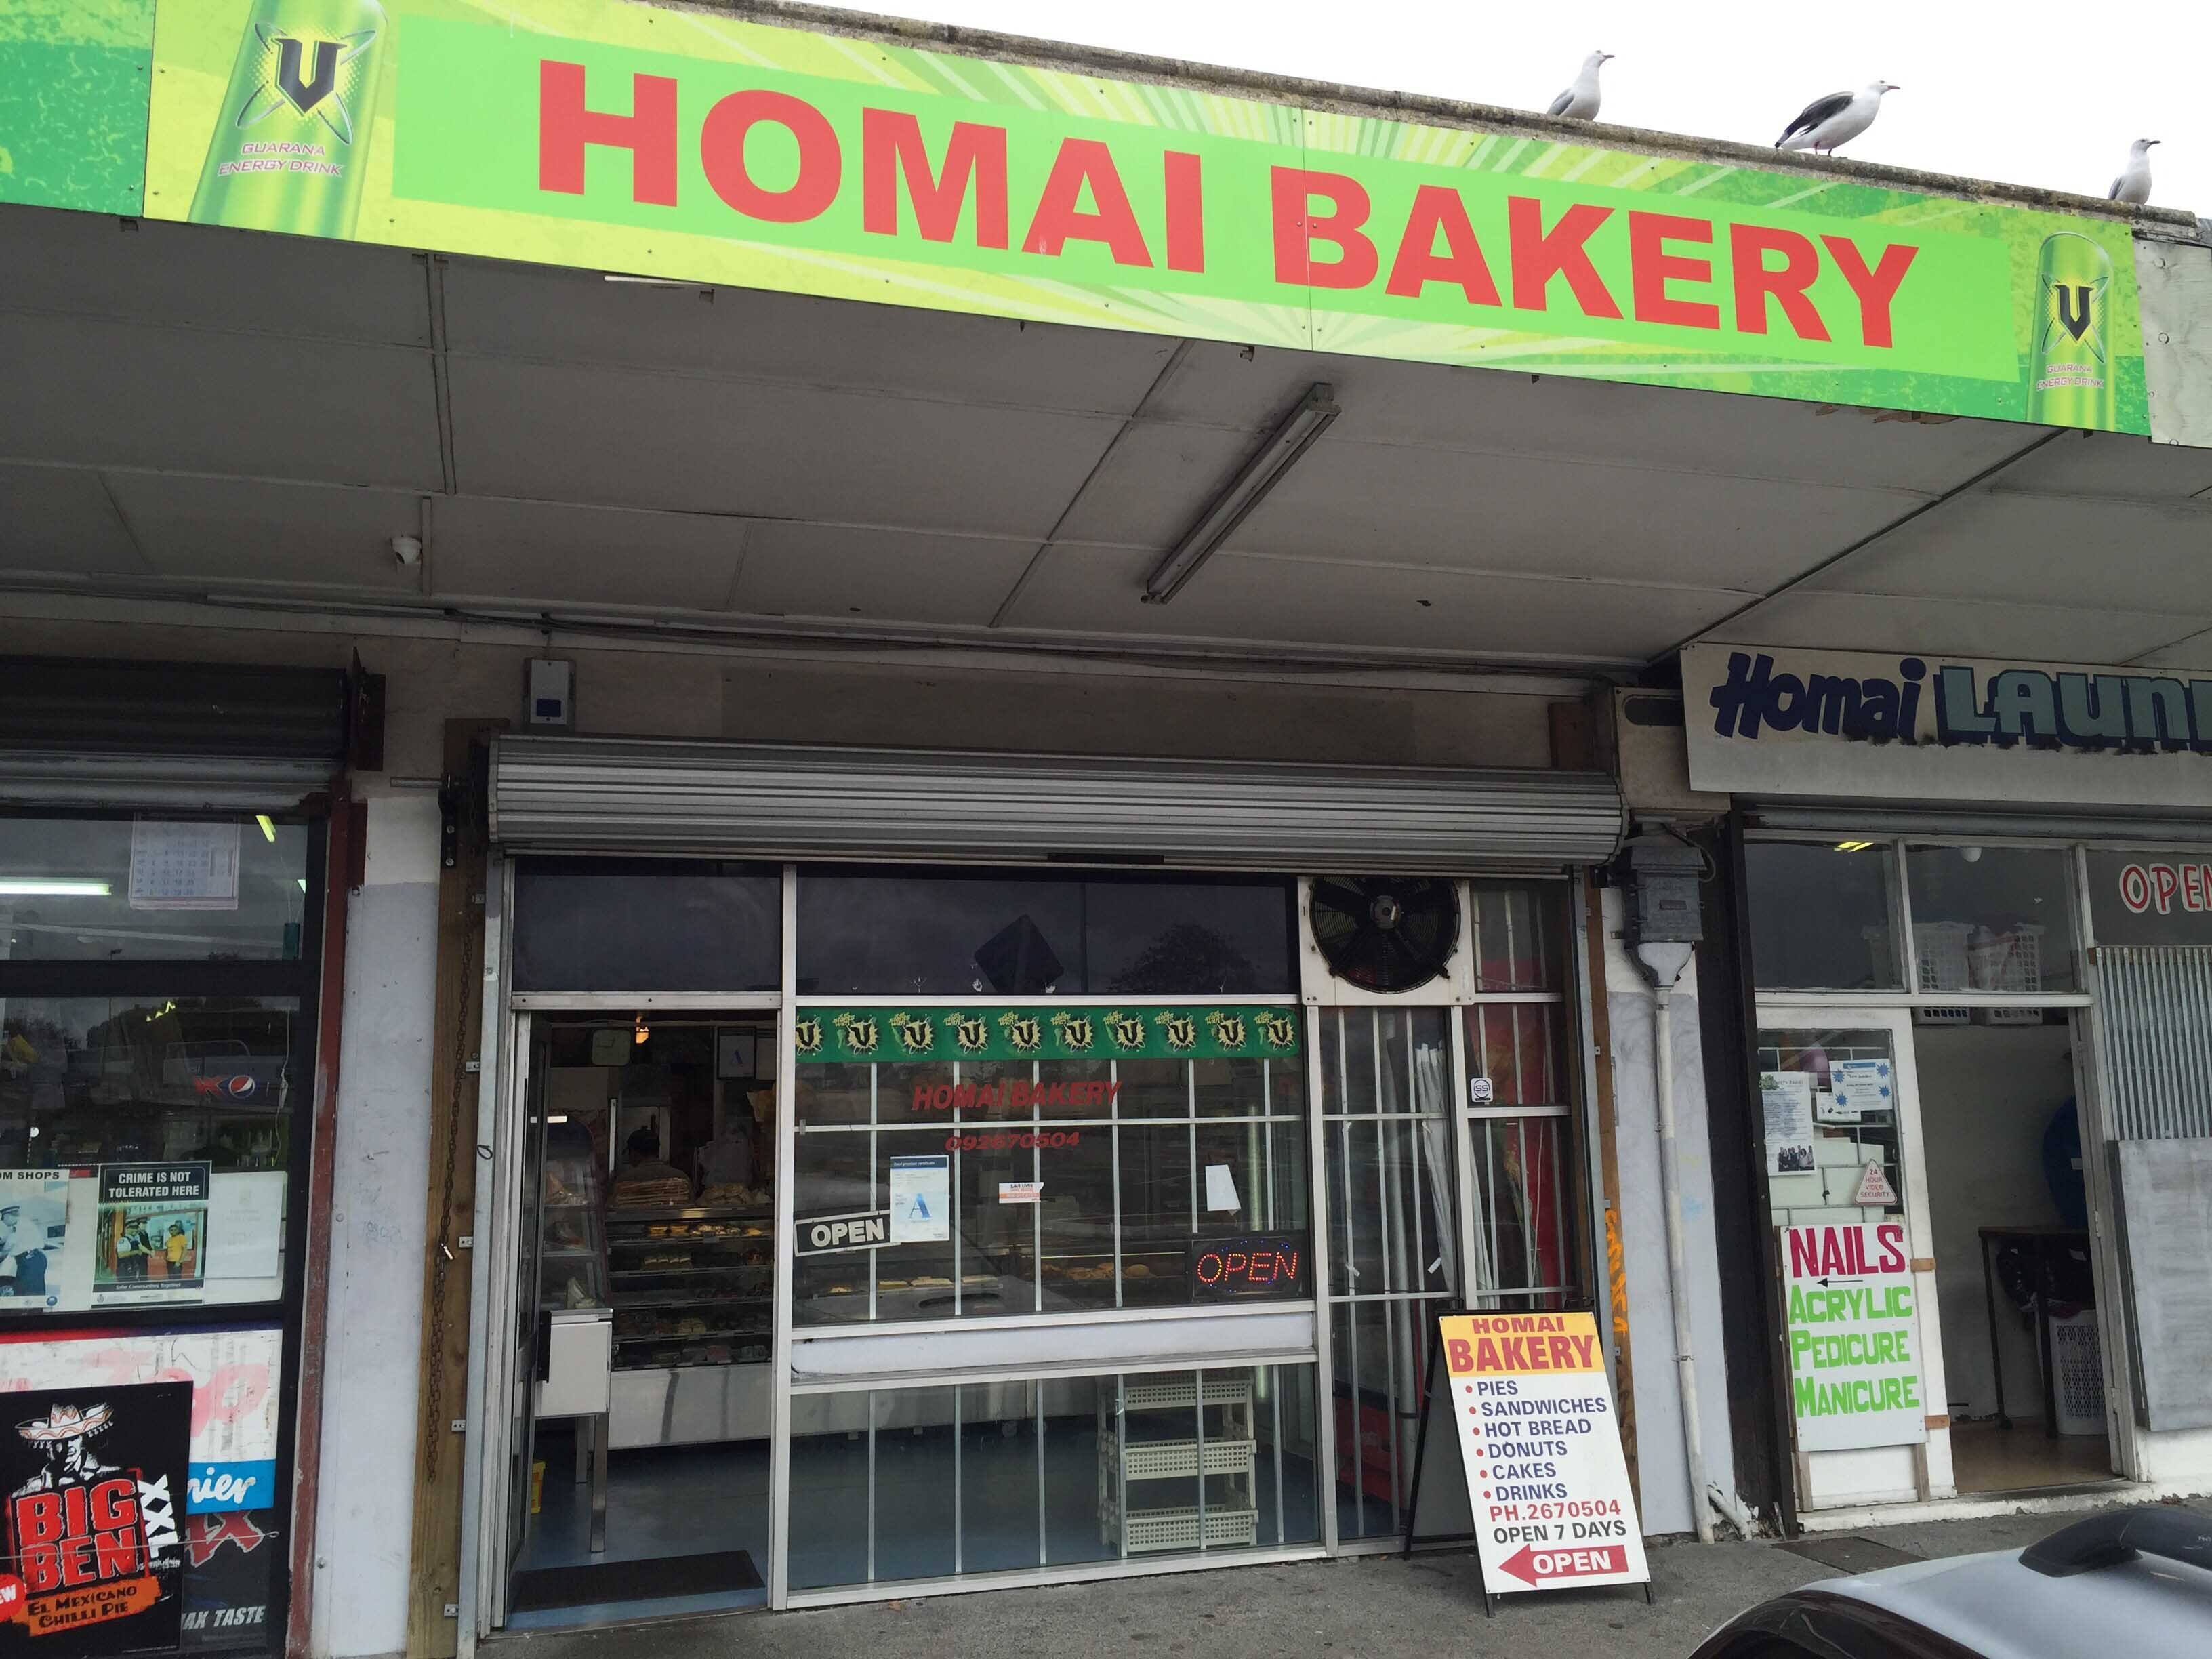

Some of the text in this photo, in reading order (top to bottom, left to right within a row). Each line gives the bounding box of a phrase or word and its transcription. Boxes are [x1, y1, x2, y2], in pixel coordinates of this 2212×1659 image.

[242, 142, 325, 156] GUARANA
[218, 159, 343, 177] ENERGY DRINK
[540, 59, 1919, 348] HOMAI BAKERY
[2046, 363, 2093, 374] GUARANA
[2036, 377, 2104, 391] ENERGY DRINK
[1710, 652, 1927, 741] Homai
[912, 1080, 1122, 1111] HOMAI BAKERY
[945, 1132, 1080, 1151] 092670504
[18, 1171, 60, 1180] SHOPS
[119, 1171, 191, 1183] CRIME IS NOT
[108, 1185, 199, 1198] TOLERATED HERE
[908, 1193, 933, 1218] A
[811, 1218, 884, 1247] OPEN
[1789, 1225, 1906, 1278] NAILS
[1197, 1251, 1298, 1284] OPEN
[1788, 1285, 1912, 1324] ACRYLIC
[1473, 1316, 1565, 1334] HOMAI
[1448, 1334, 1595, 1372] BAKERY
[1790, 1330, 1910, 1370] PEDICURE
[1477, 1380, 1518, 1396] PIES
[1794, 1376, 1919, 1418] MANICURE
[1481, 1397, 1607, 1417] SANDWICHES
[1485, 1418, 1591, 1438] HOT BREAD
[1488, 1441, 1567, 1458] DONUTS
[1492, 1462, 1556, 1480] CAKES
[1496, 1483, 1568, 1502] DRINKS
[16, 1479, 138, 1546] BIG
[137, 1475, 180, 1558] XXL
[1490, 1499, 1621, 1522] PH.2670504
[1494, 1519, 1626, 1544] OPEN 7 DAYS
[20, 1528, 137, 1594] BEN
[1532, 1550, 1612, 1574] OPEN
[28, 1586, 138, 1616] EL MEXICANO
[39, 1602, 129, 1629] CHILLI PIE
[213, 1606, 266, 1627] TASTE
